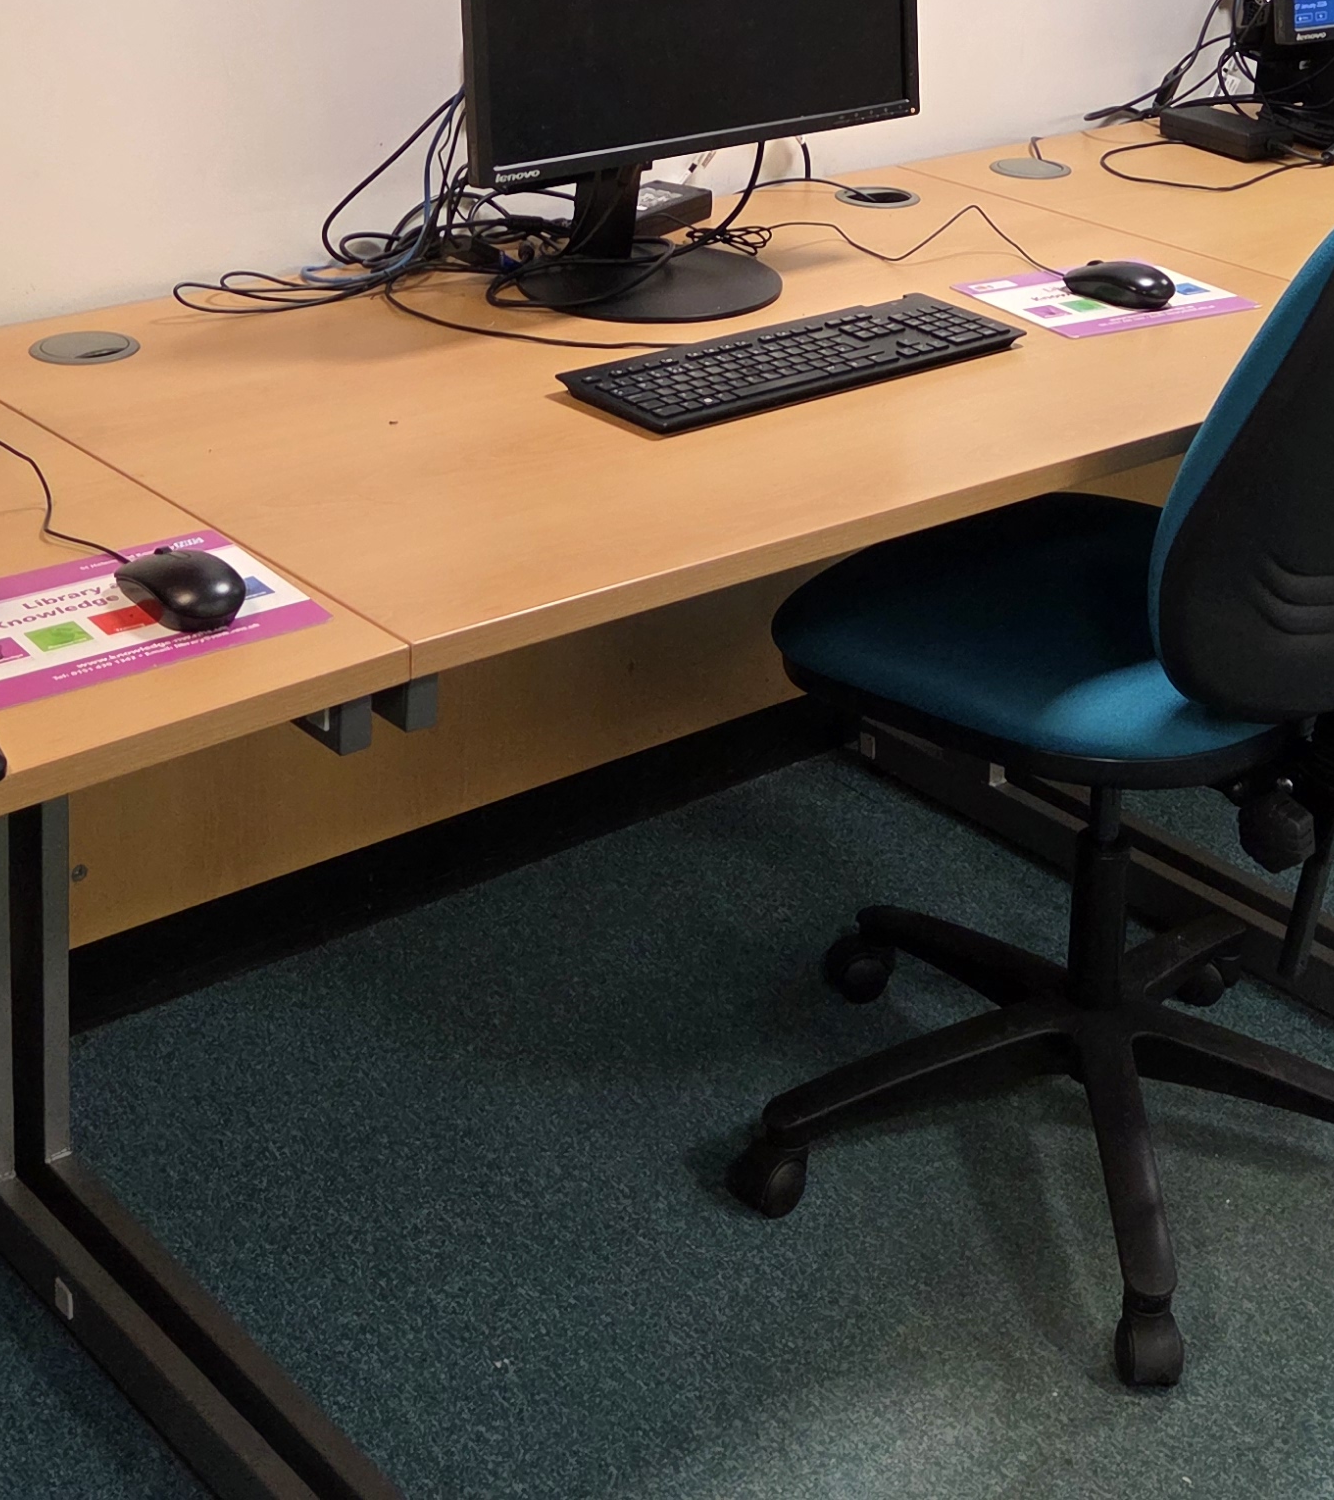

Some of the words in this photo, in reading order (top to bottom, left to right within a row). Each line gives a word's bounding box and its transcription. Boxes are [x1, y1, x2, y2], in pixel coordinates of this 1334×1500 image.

[1296, 31, 1327, 41] lenovo
[495, 169, 540, 183] lenovo
[22, 586, 101, 610] Library
